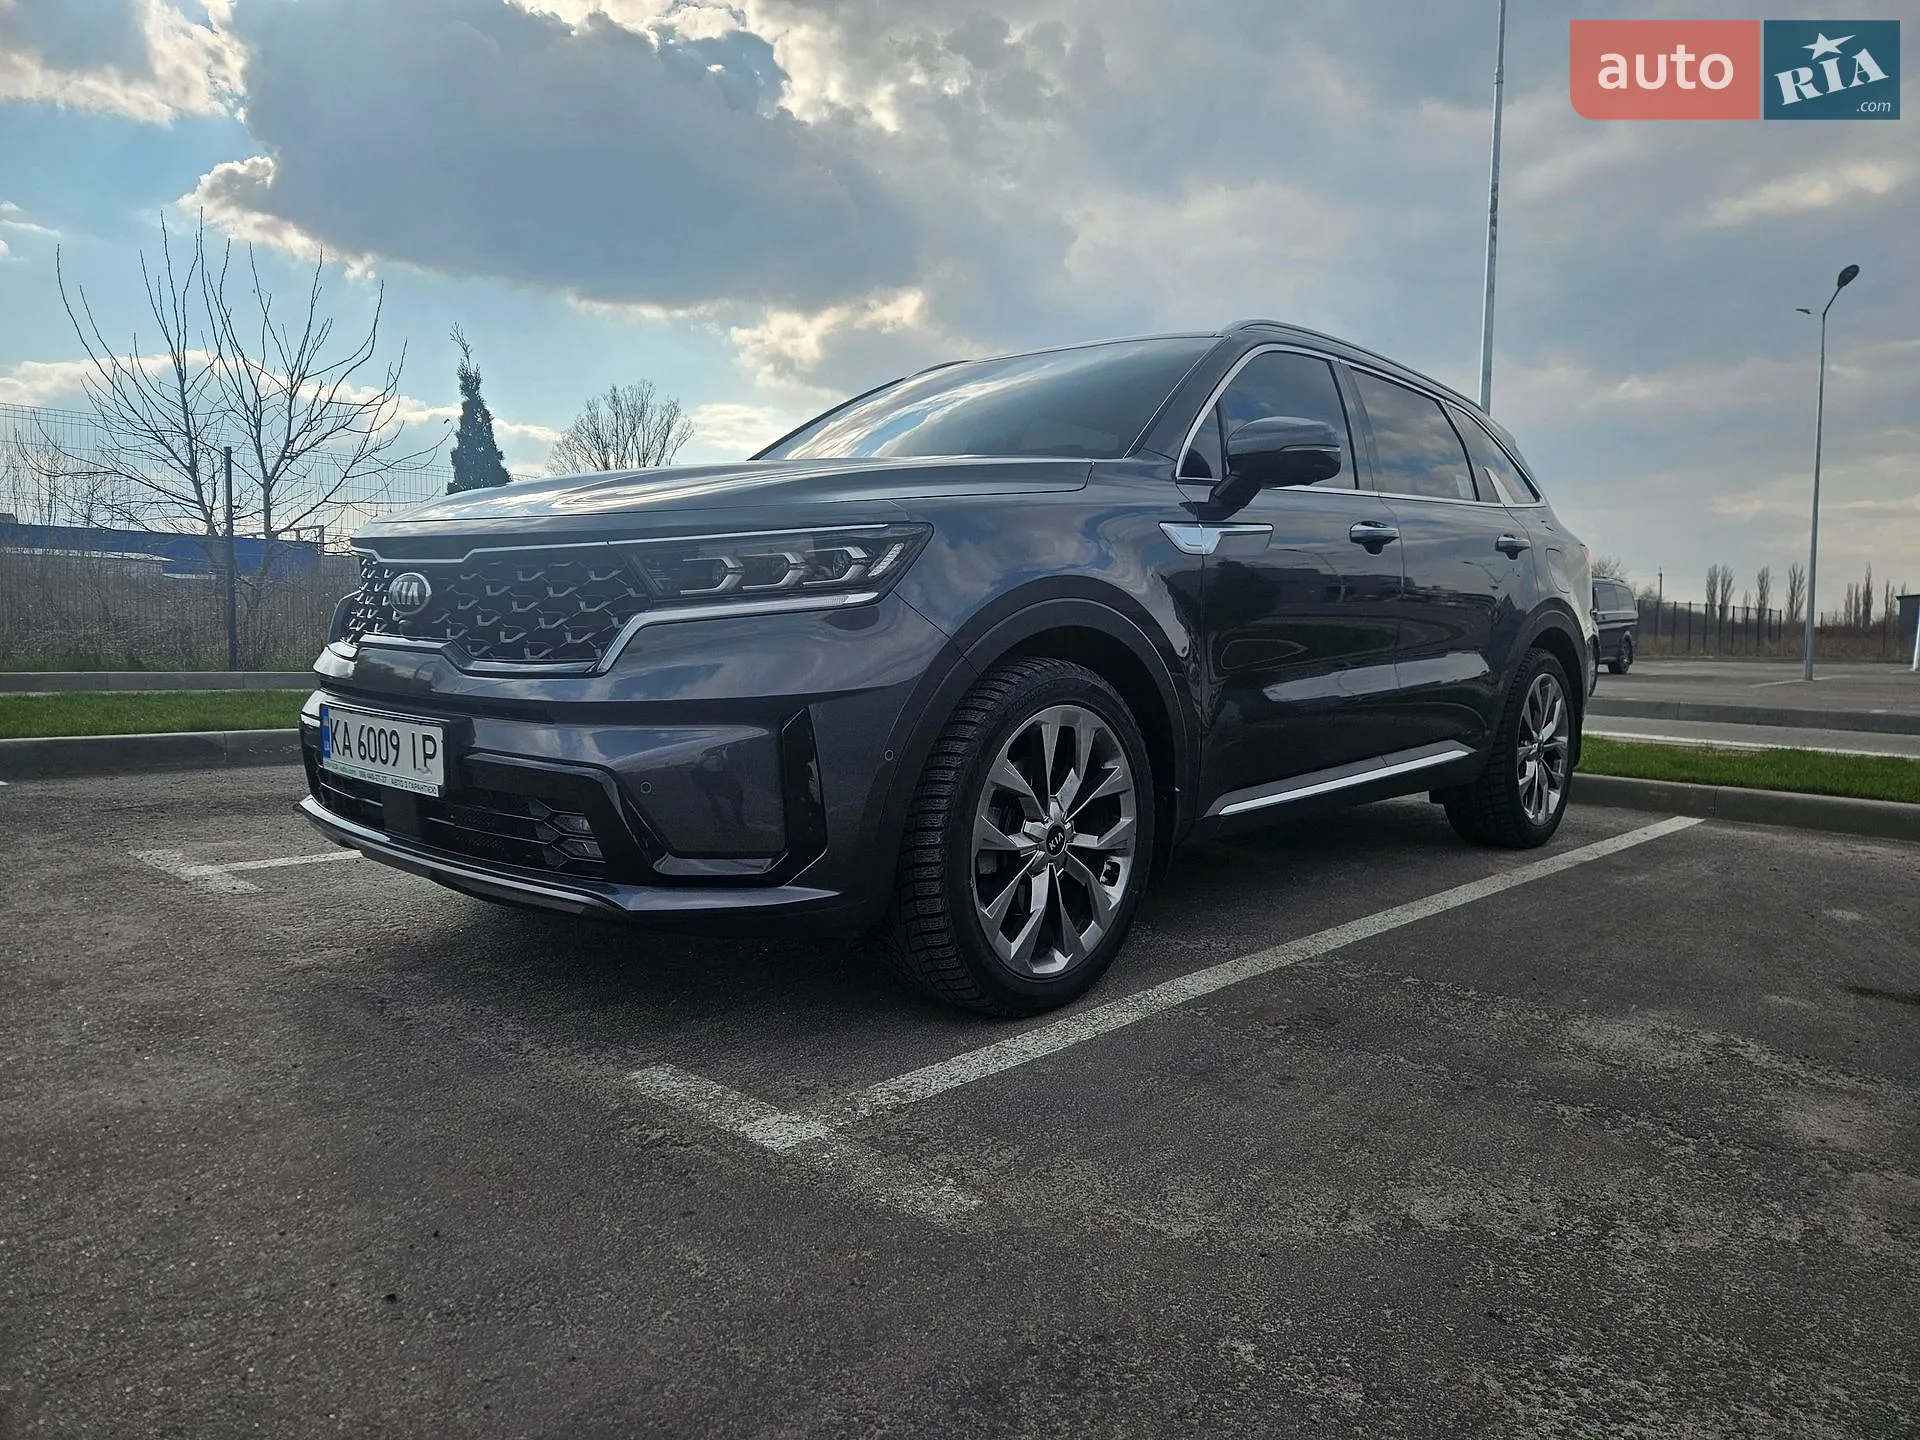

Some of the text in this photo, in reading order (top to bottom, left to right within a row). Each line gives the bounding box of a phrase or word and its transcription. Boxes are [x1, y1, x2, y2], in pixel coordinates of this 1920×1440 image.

[391, 581, 420, 605] KIA
[330, 718, 437, 770] KA 6009 IP
[1048, 831, 1064, 851] KIA
